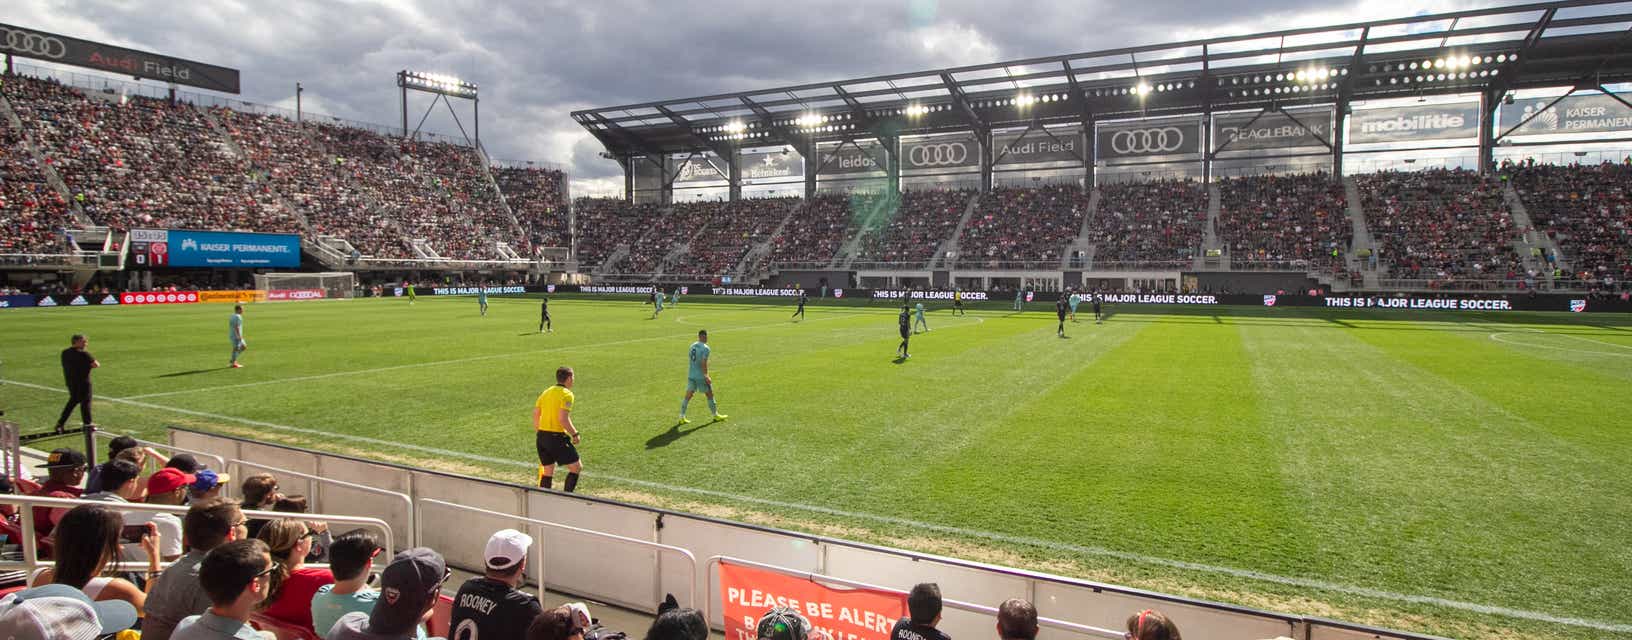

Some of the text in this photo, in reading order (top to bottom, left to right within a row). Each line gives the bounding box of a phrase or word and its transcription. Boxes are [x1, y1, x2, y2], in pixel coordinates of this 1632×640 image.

[88, 51, 190, 80] Audi Field
[1566, 106, 1606, 119] KAISER
[1362, 113, 1465, 134] mobilitie
[1239, 126, 1323, 140] EAGLEBANK
[1000, 140, 1074, 156] Audi Field
[839, 154, 876, 169] leidos
[200, 243, 230, 251] KAISER
[136, 254, 145, 264] 0
[156, 254, 163, 264] 1
[457, 287, 478, 295] MAJOR
[616, 286, 636, 294] LEAGUE
[733, 288, 754, 296] MAJOR
[890, 291, 898, 299] IS
[925, 291, 955, 300] LEAGUE
[959, 291, 989, 300] OCCER.
[1104, 294, 1136, 303] MAJOR
[1139, 294, 1175, 304] LEAGUE
[1177, 295, 1218, 304] SOCCER.
[1325, 297, 1351, 307] THIS
[1353, 298, 1365, 307] IS
[1410, 298, 1457, 309] LEAGUE
[1459, 299, 1512, 310] SOCCER.
[460, 593, 497, 616] ROONEY
[727, 587, 800, 611] PLEASE
[806, 602, 833, 619] BE
[839, 607, 898, 635] ALERT
